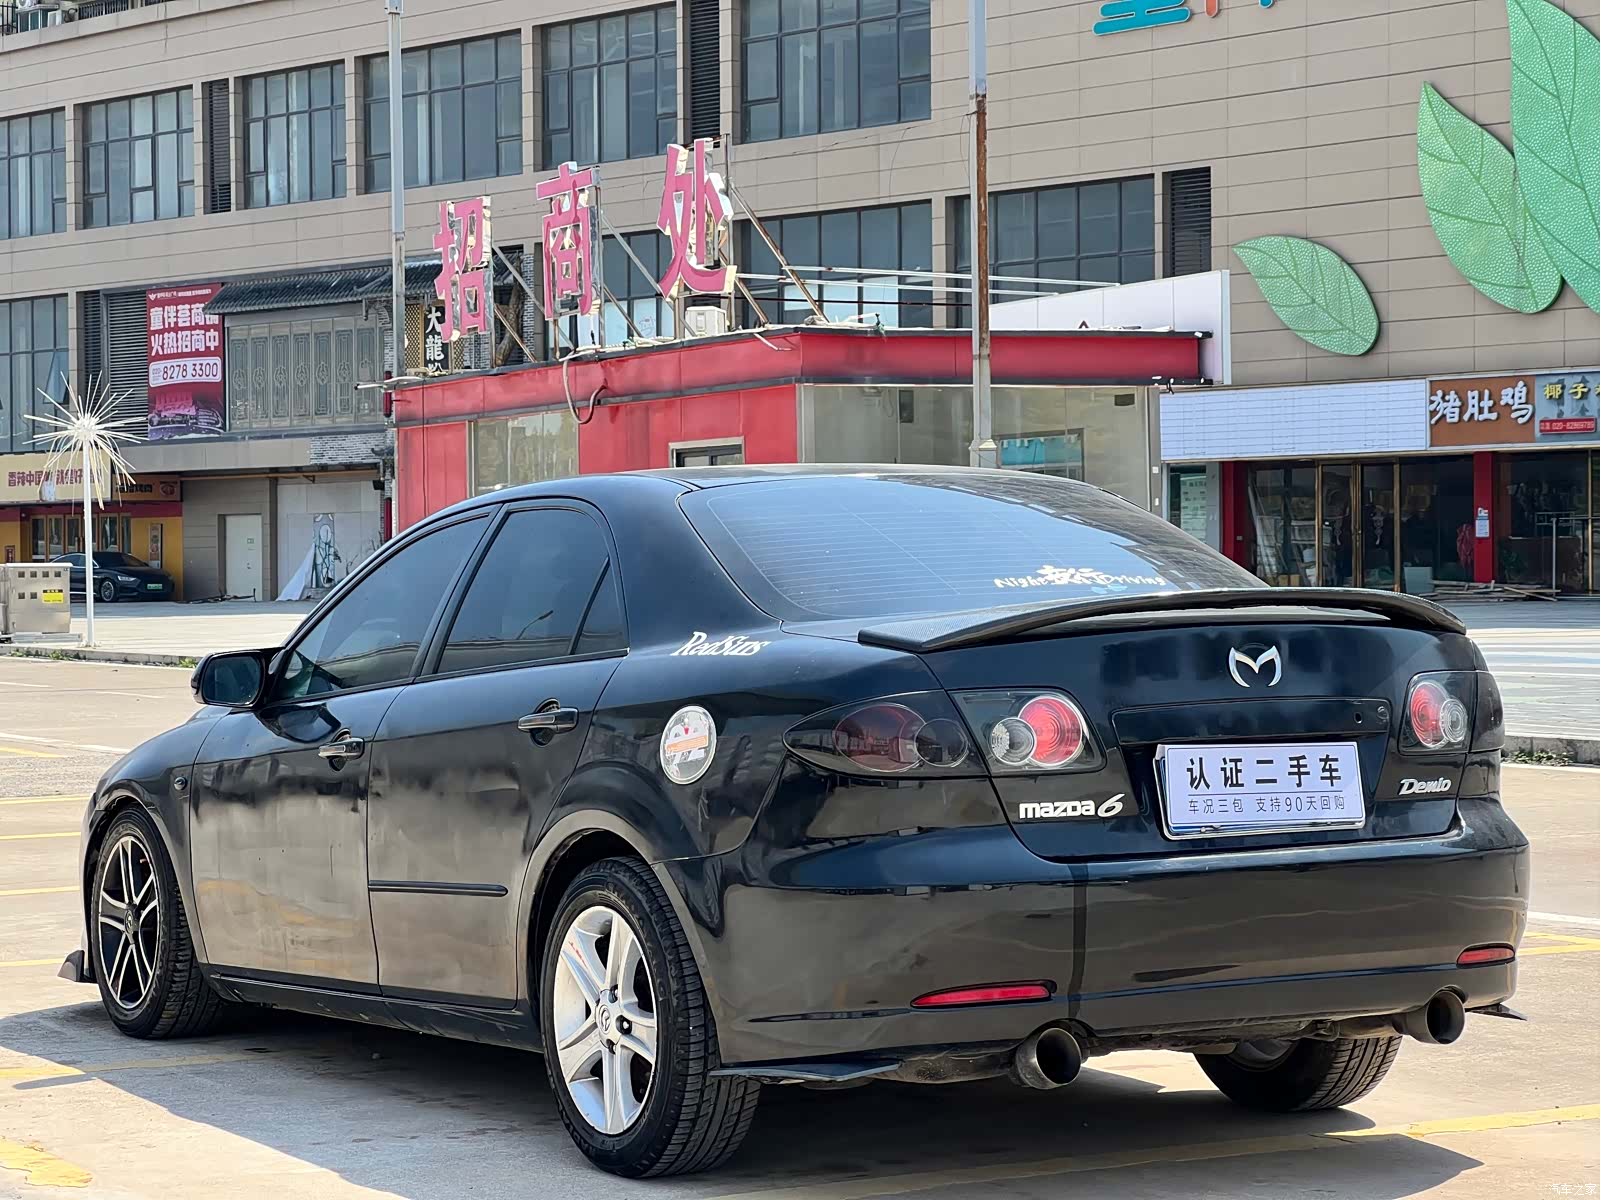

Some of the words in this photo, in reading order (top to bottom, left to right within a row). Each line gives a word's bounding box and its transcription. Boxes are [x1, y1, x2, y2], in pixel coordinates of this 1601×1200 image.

[433, 137, 738, 343] 招商处
[150, 329, 219, 357] 火热招商中
[162, 363, 188, 381] 8278
[191, 362, 218, 378] 3300
[1428, 380, 1534, 425] 猪肚鸡
[1186, 754, 1341, 790] 认证二手车
[1398, 777, 1452, 795] Demio
[1097, 793, 1126, 818] 6
[1188, 798, 1244, 814] 车况三包
[1255, 795, 1345, 813] 支持90天回购
